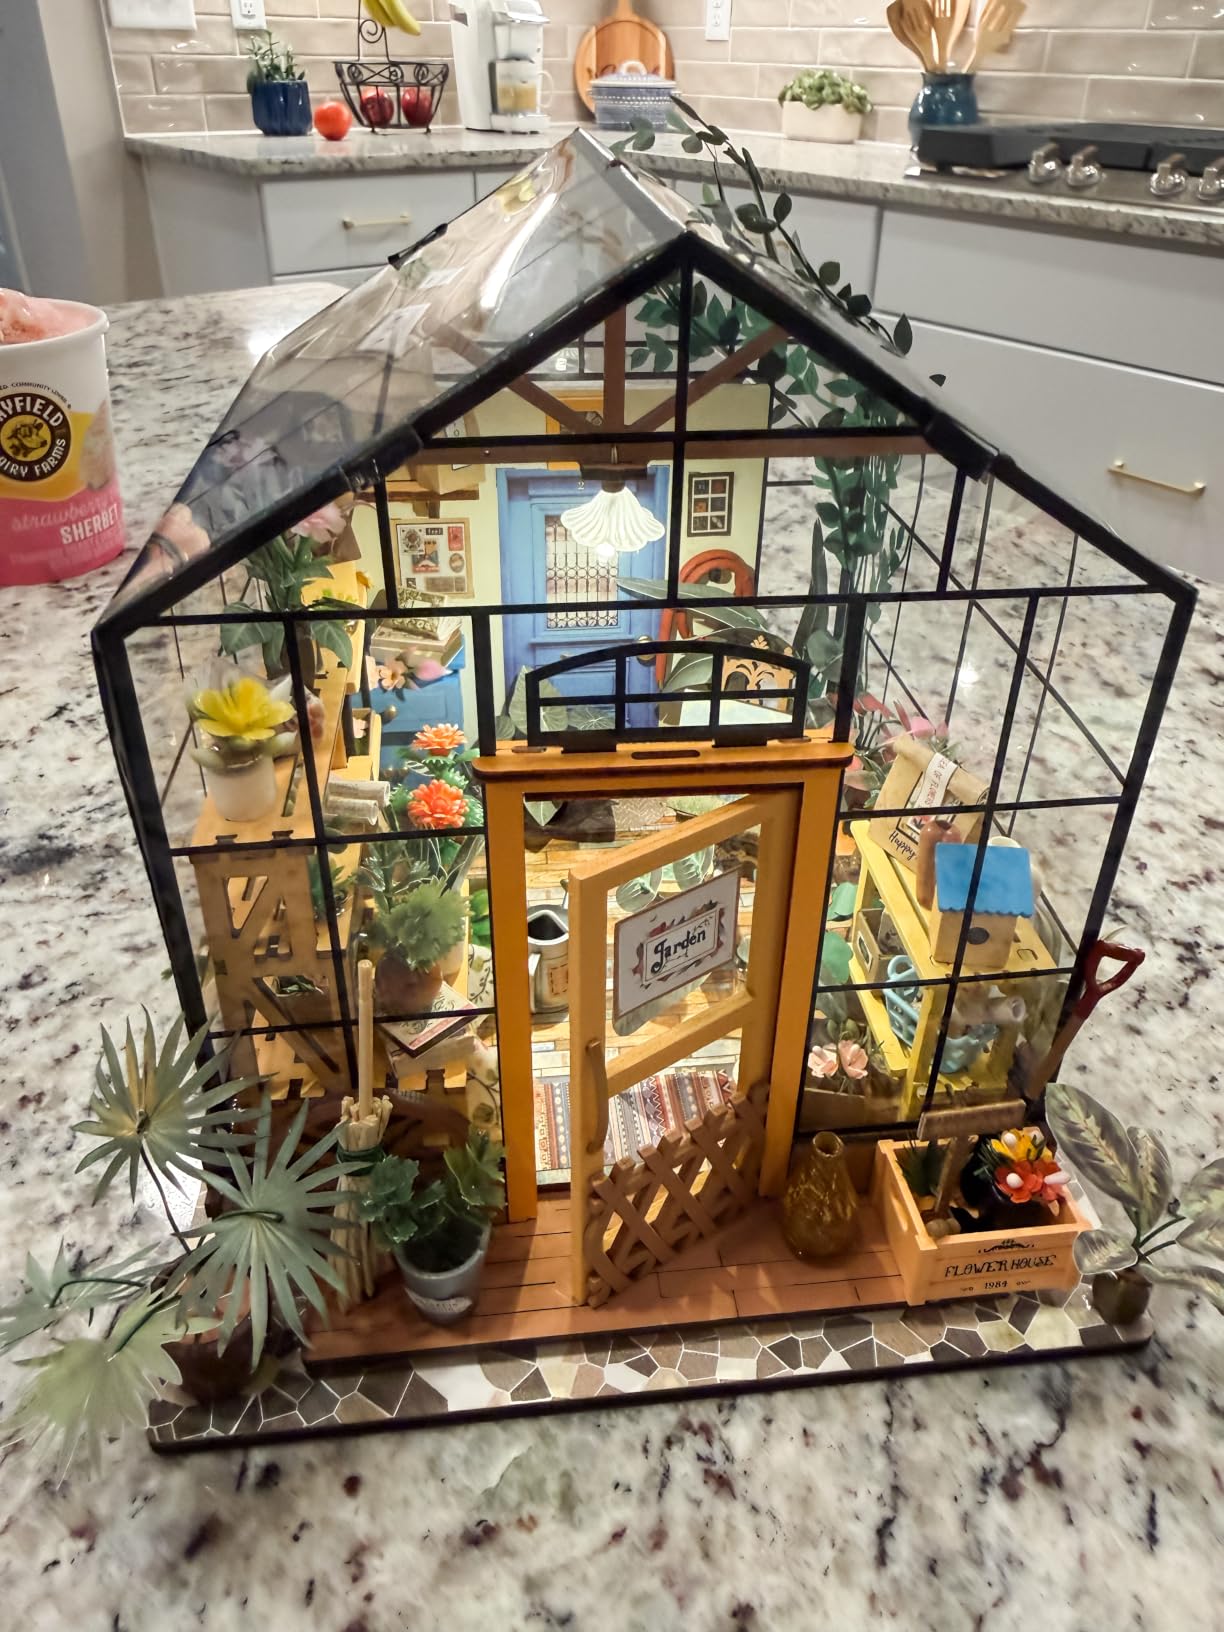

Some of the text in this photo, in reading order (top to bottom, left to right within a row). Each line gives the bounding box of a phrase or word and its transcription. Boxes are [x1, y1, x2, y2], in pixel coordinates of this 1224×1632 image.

[11, 381, 50, 391] COMMUNITY
[34, 438, 66, 477] FARMS
[60, 503, 118, 545] SHERBET
[888, 830, 916, 861] Happy
[650, 929, 706, 974] Garden
[944, 1254, 1057, 1278] FLOWER HOUSE
